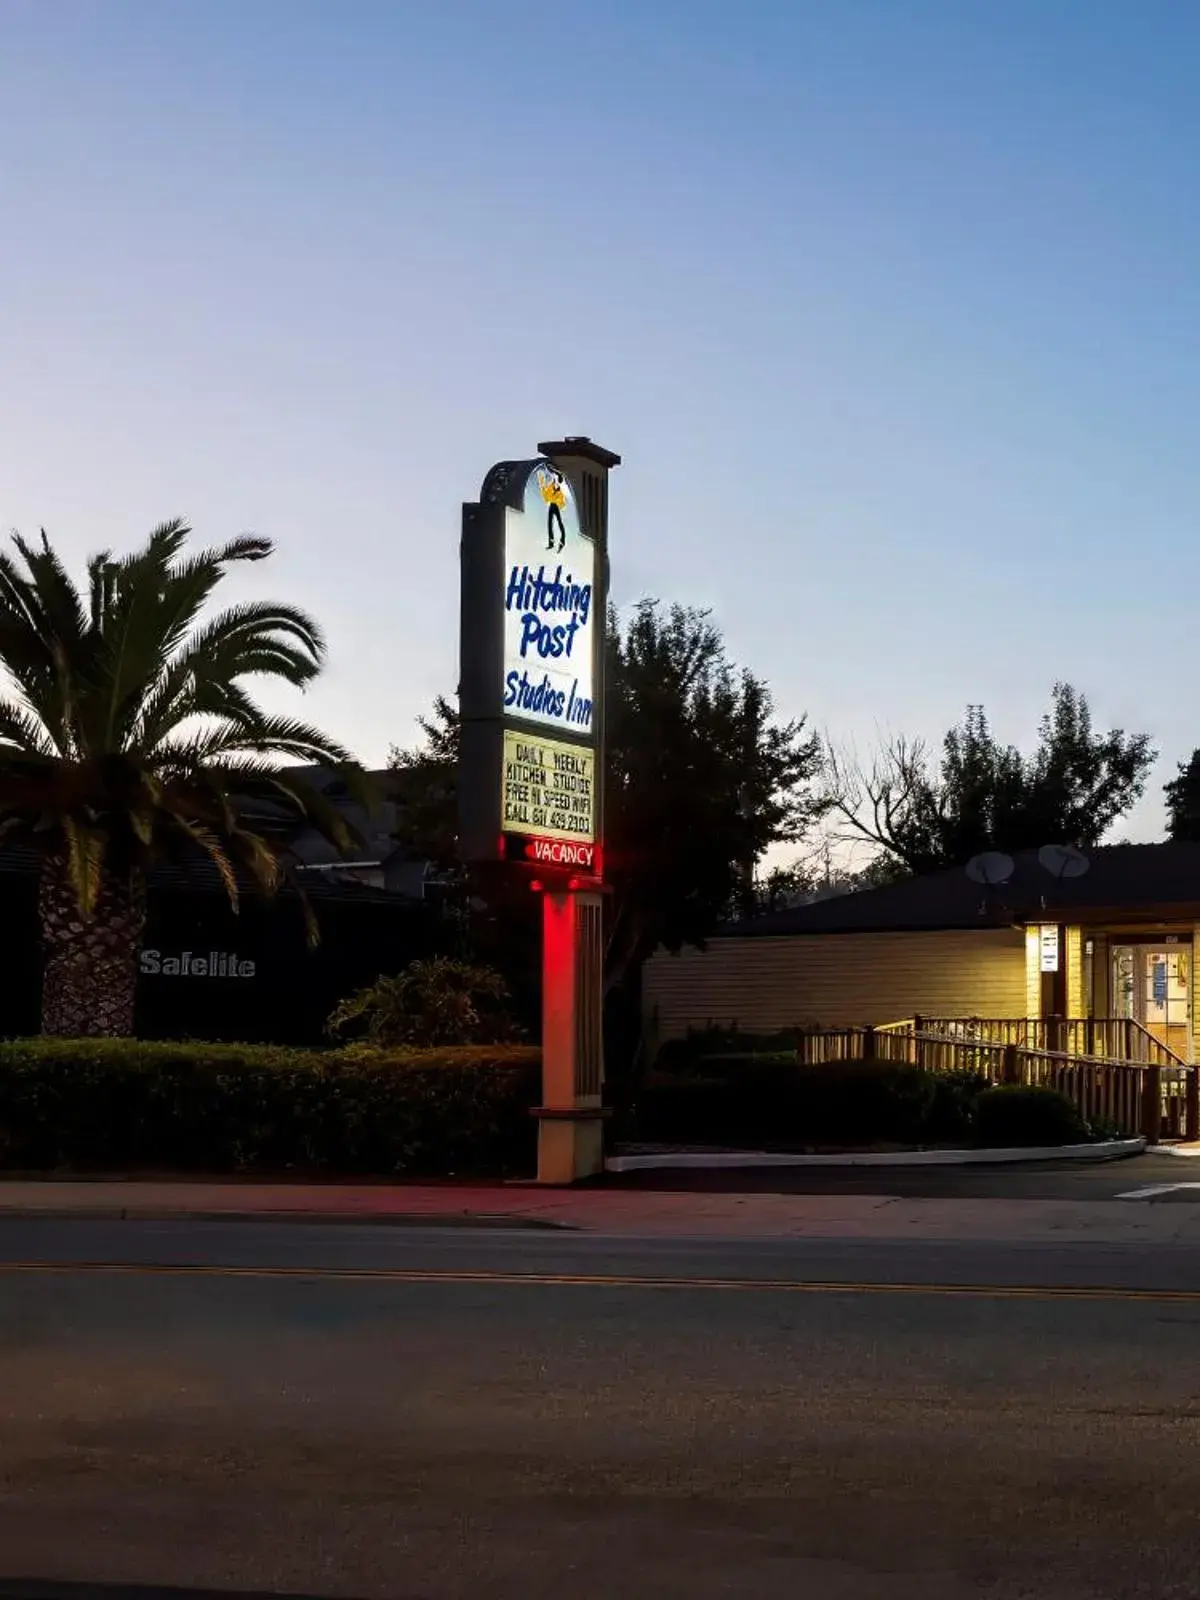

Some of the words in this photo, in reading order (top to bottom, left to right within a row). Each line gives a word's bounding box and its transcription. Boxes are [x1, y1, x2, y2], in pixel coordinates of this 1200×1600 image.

[506, 565, 592, 624] Hitching
[519, 612, 579, 658] Post
[504, 670, 566, 719] Studios
[566, 678, 593, 726] Inn
[516, 743, 544, 767] DAILY
[553, 751, 586, 775] WEEKLY
[506, 761, 546, 786] KITCHEN
[506, 782, 529, 803] FREE
[544, 790, 570, 810] SPEED
[505, 802, 529, 823] CALL
[534, 840, 593, 866] VACANCY
[140, 949, 256, 977] Safelite
